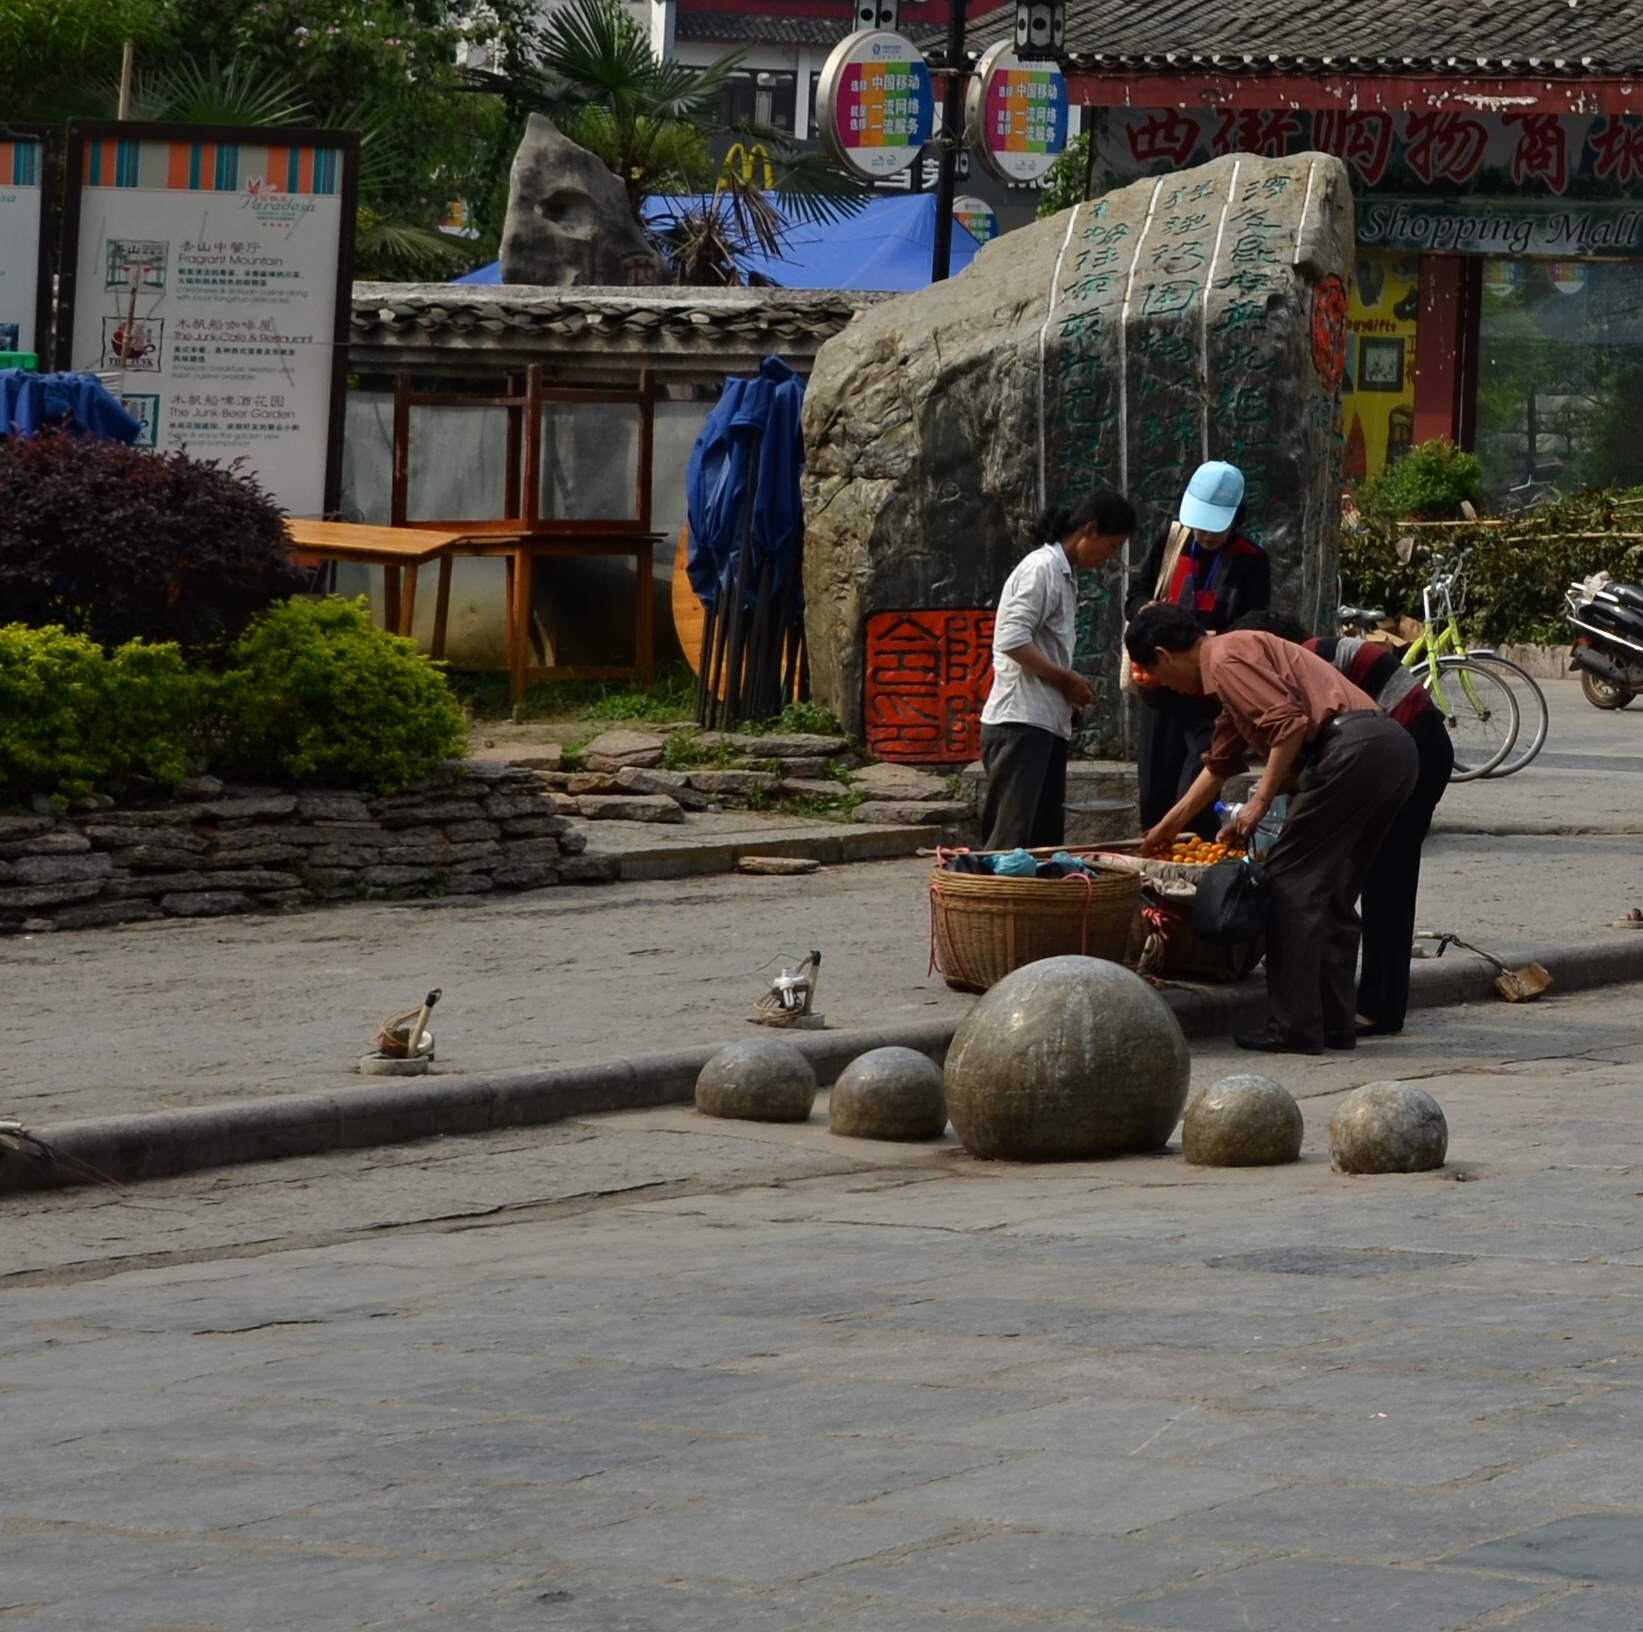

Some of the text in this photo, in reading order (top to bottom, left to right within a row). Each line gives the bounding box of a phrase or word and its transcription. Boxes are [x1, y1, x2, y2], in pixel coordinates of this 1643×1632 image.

[850, 74, 920, 92] 选择 中国移动
[1017, 81, 1058, 100] 中国移动
[871, 98, 919, 115] 一流网络
[1015, 106, 1057, 123] 一流网络
[850, 118, 919, 135] 选择 一流服务
[1015, 126, 1056, 143] 一流服务
[1358, 202, 1534, 250] Shopping
[181, 240, 261, 253] 香山中餐厅
[178, 253, 283, 266] Fragrant Mountain
[176, 319, 272, 331] 木帆船咖啡屋
[174, 331, 192, 341] The
[260, 334, 313, 344] Restaurant
[171, 395, 285, 407] 木帆船啤酒花园
[170, 408, 189, 417] The
[251, 408, 296, 419] Garden
